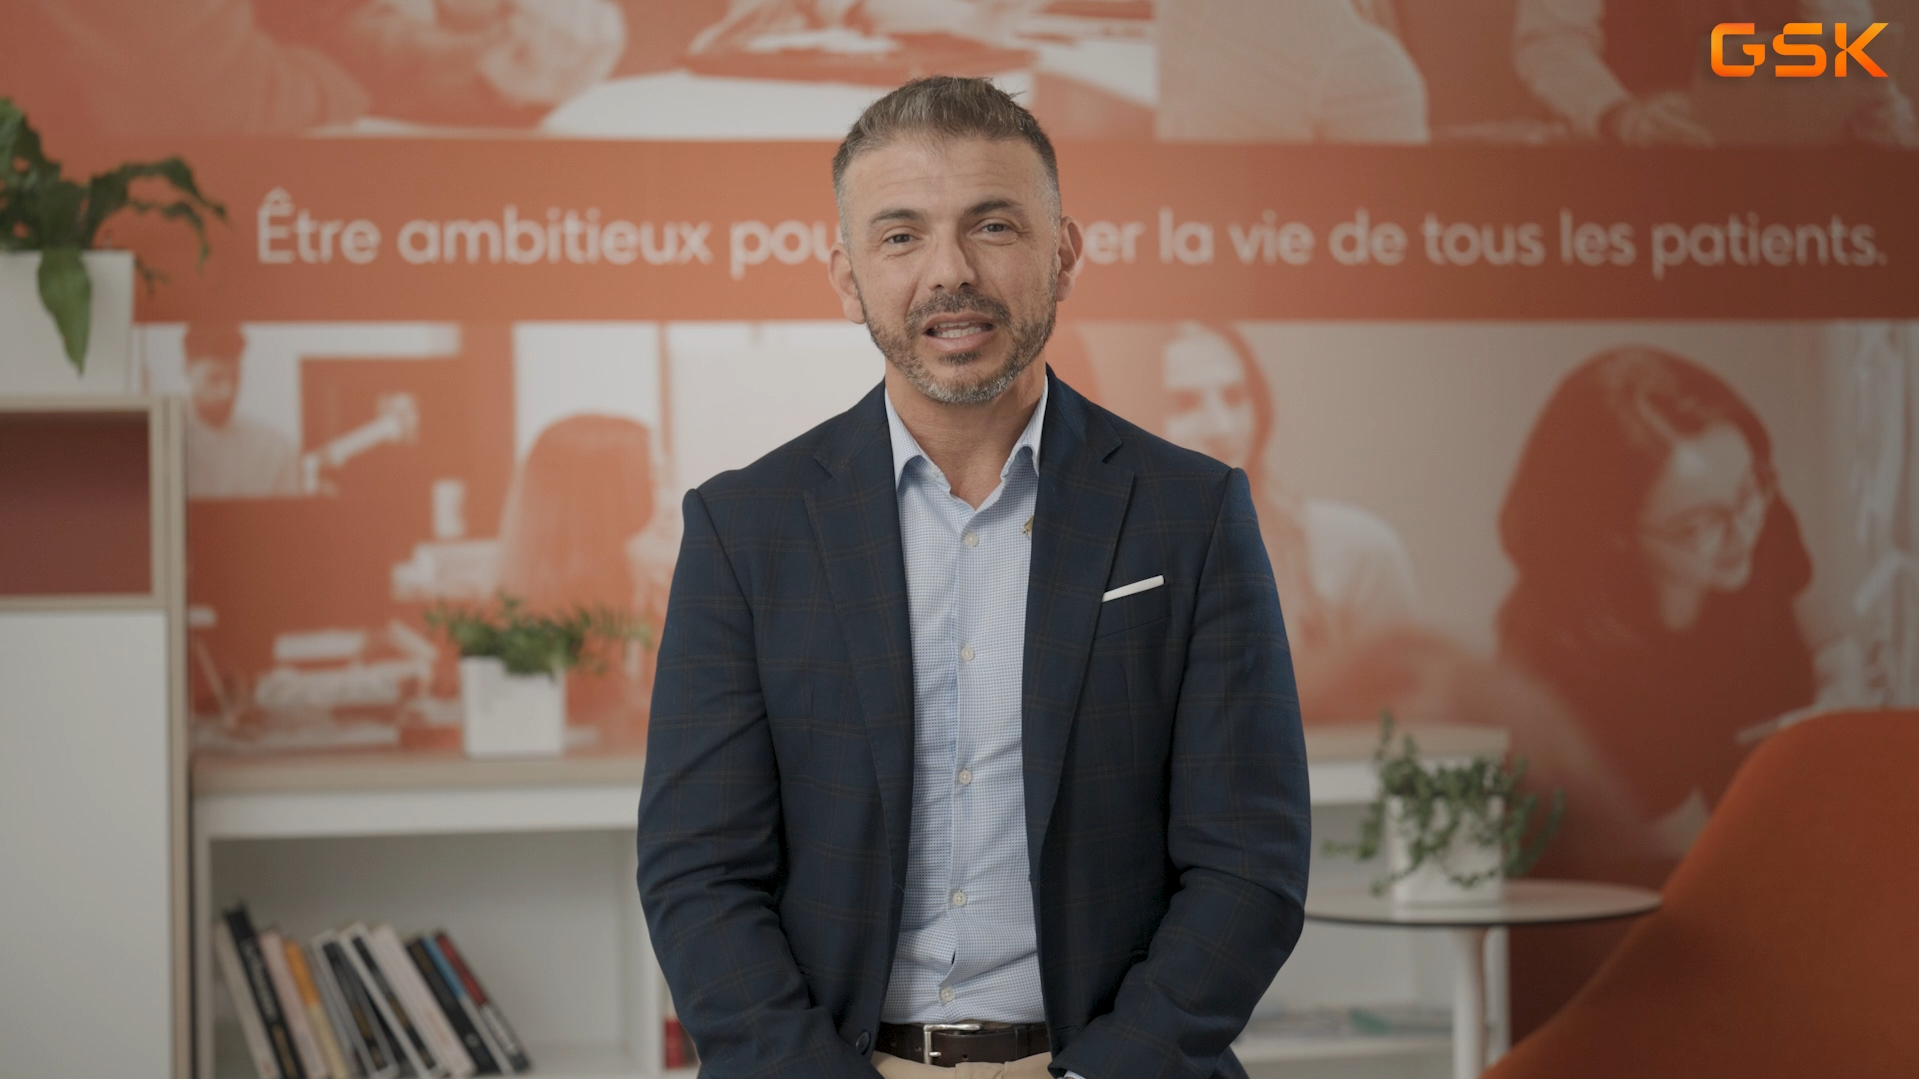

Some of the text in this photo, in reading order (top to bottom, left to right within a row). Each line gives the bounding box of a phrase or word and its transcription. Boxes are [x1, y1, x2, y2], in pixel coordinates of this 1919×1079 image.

[257, 187, 1889, 281] Être ambitieux pou er la vie de tous les patients.
